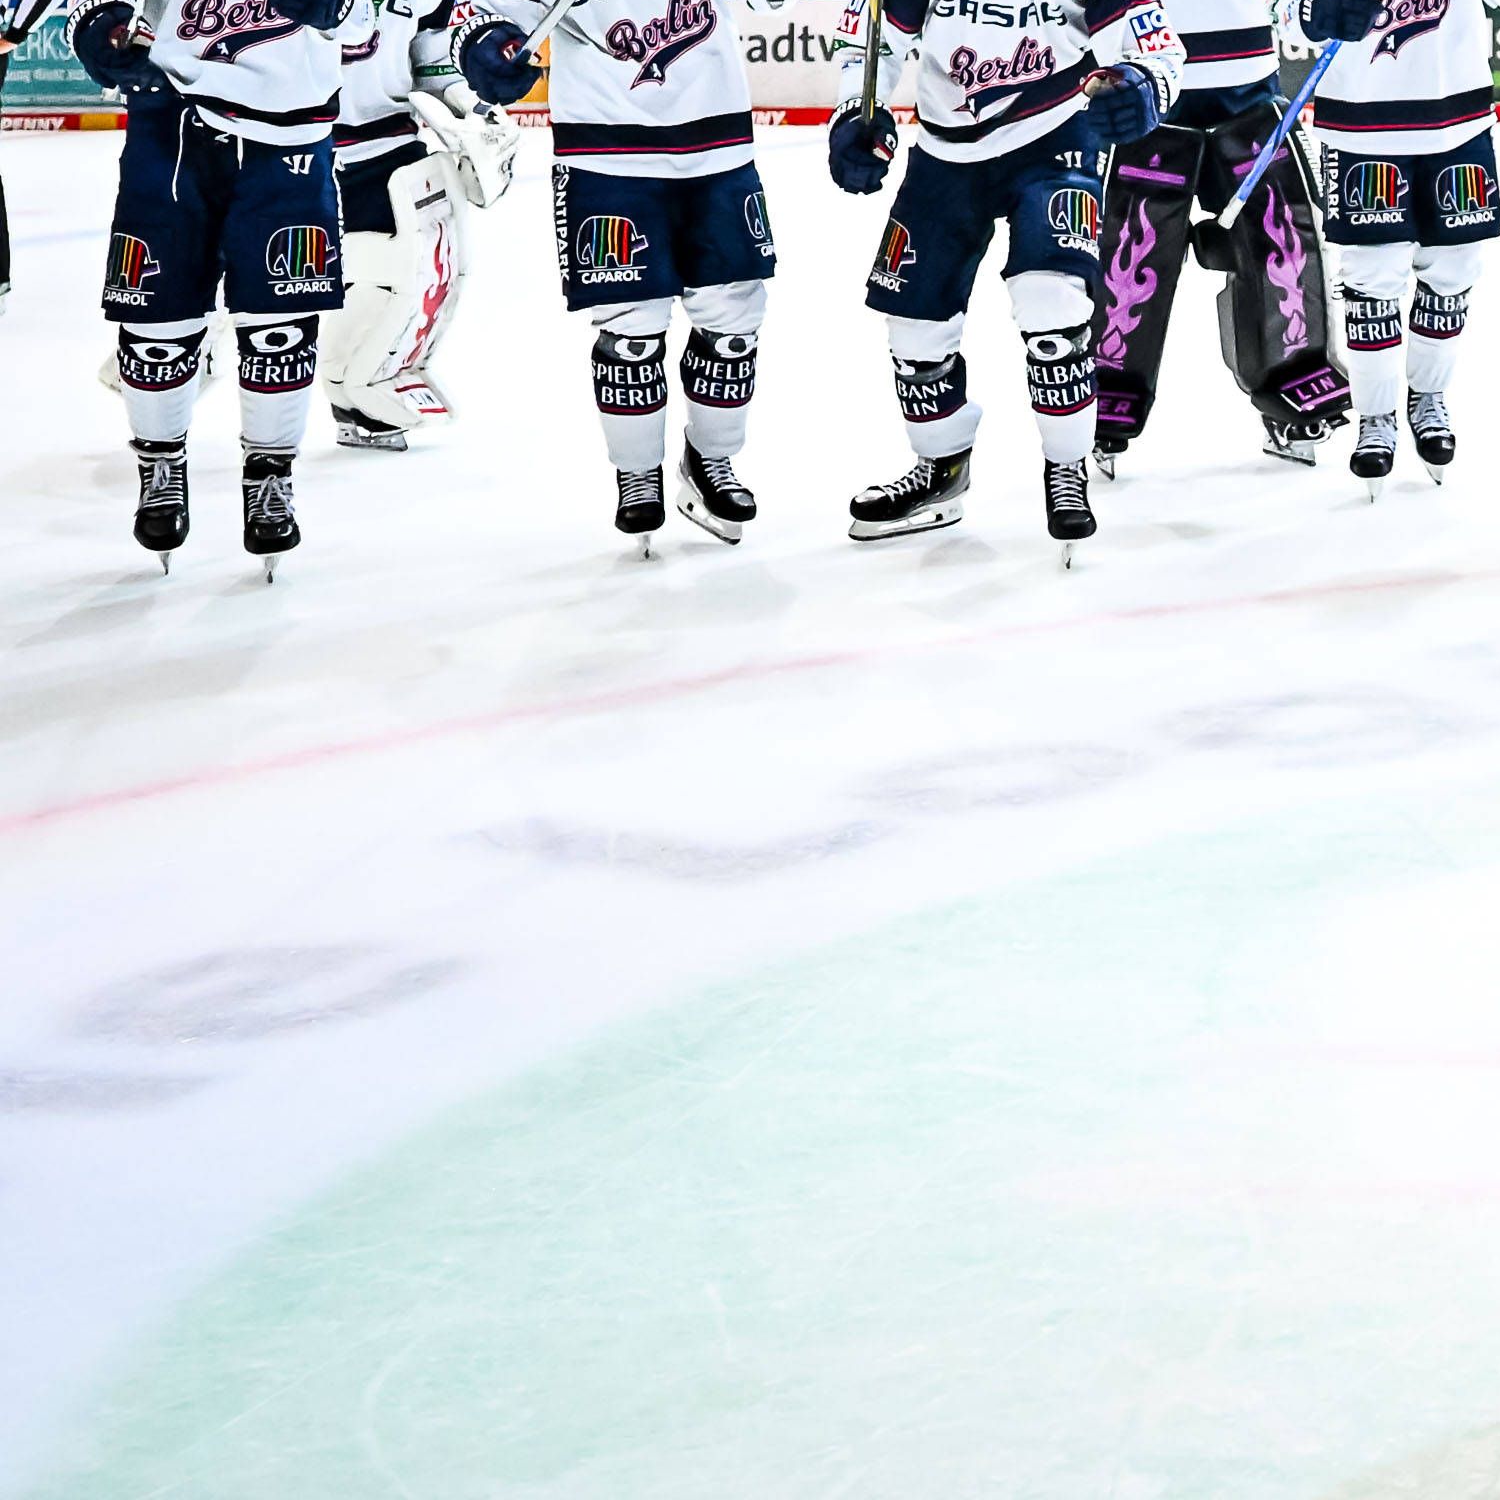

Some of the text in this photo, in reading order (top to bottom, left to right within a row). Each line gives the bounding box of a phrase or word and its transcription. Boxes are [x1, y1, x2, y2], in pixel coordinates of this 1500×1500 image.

[950, 36, 1057, 89] Berlin
[1327, 150, 1340, 220] TIPARK
[1351, 209, 1405, 225] CAPAROL
[1445, 209, 1496, 228] CAPAROL
[581, 268, 642, 284] CAPAROL
[274, 279, 334, 296] CAPAROL
[1296, 373, 1337, 402] LIN
